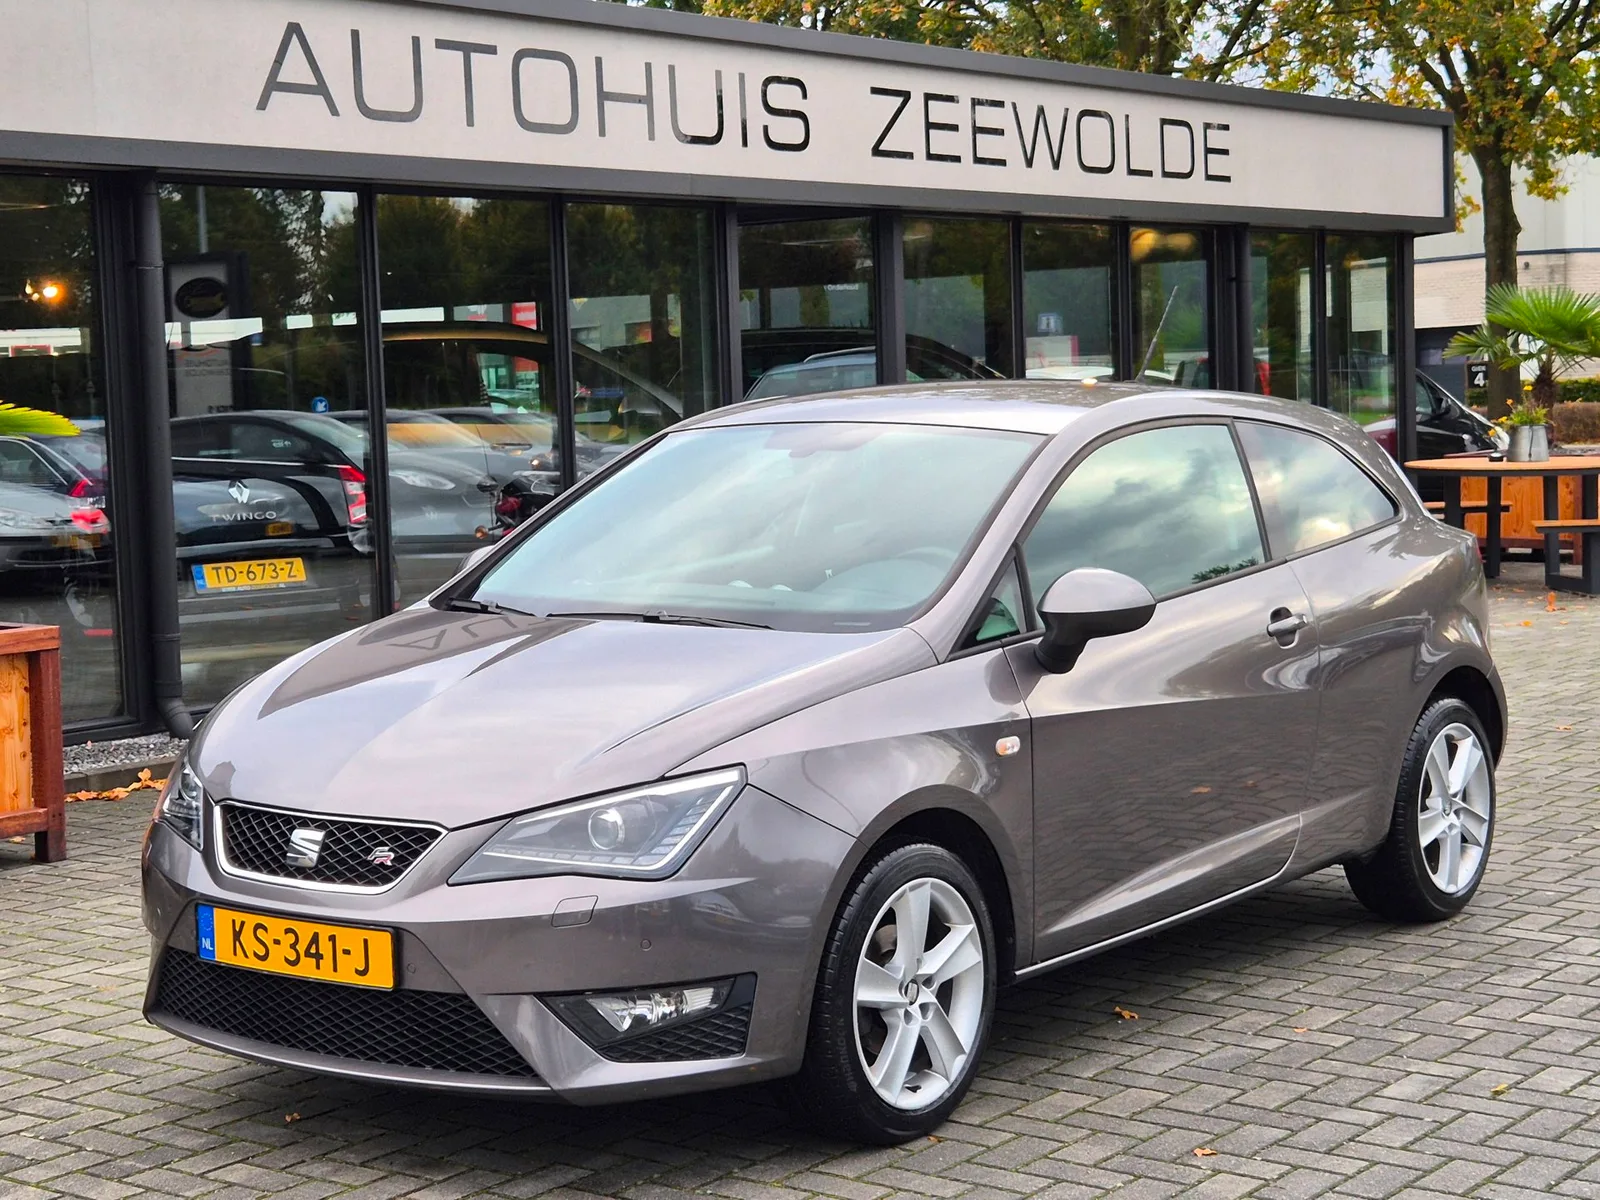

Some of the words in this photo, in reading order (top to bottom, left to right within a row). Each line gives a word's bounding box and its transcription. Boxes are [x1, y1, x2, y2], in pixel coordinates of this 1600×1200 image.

[256, 21, 810, 152] AUTOHUIS
[870, 87, 1231, 183] ZEEWOLDE
[211, 511, 276, 522] TWINGO
[212, 561, 297, 583] TD-673-Z
[202, 938, 213, 950] NL
[231, 919, 369, 977] KS-341-J
